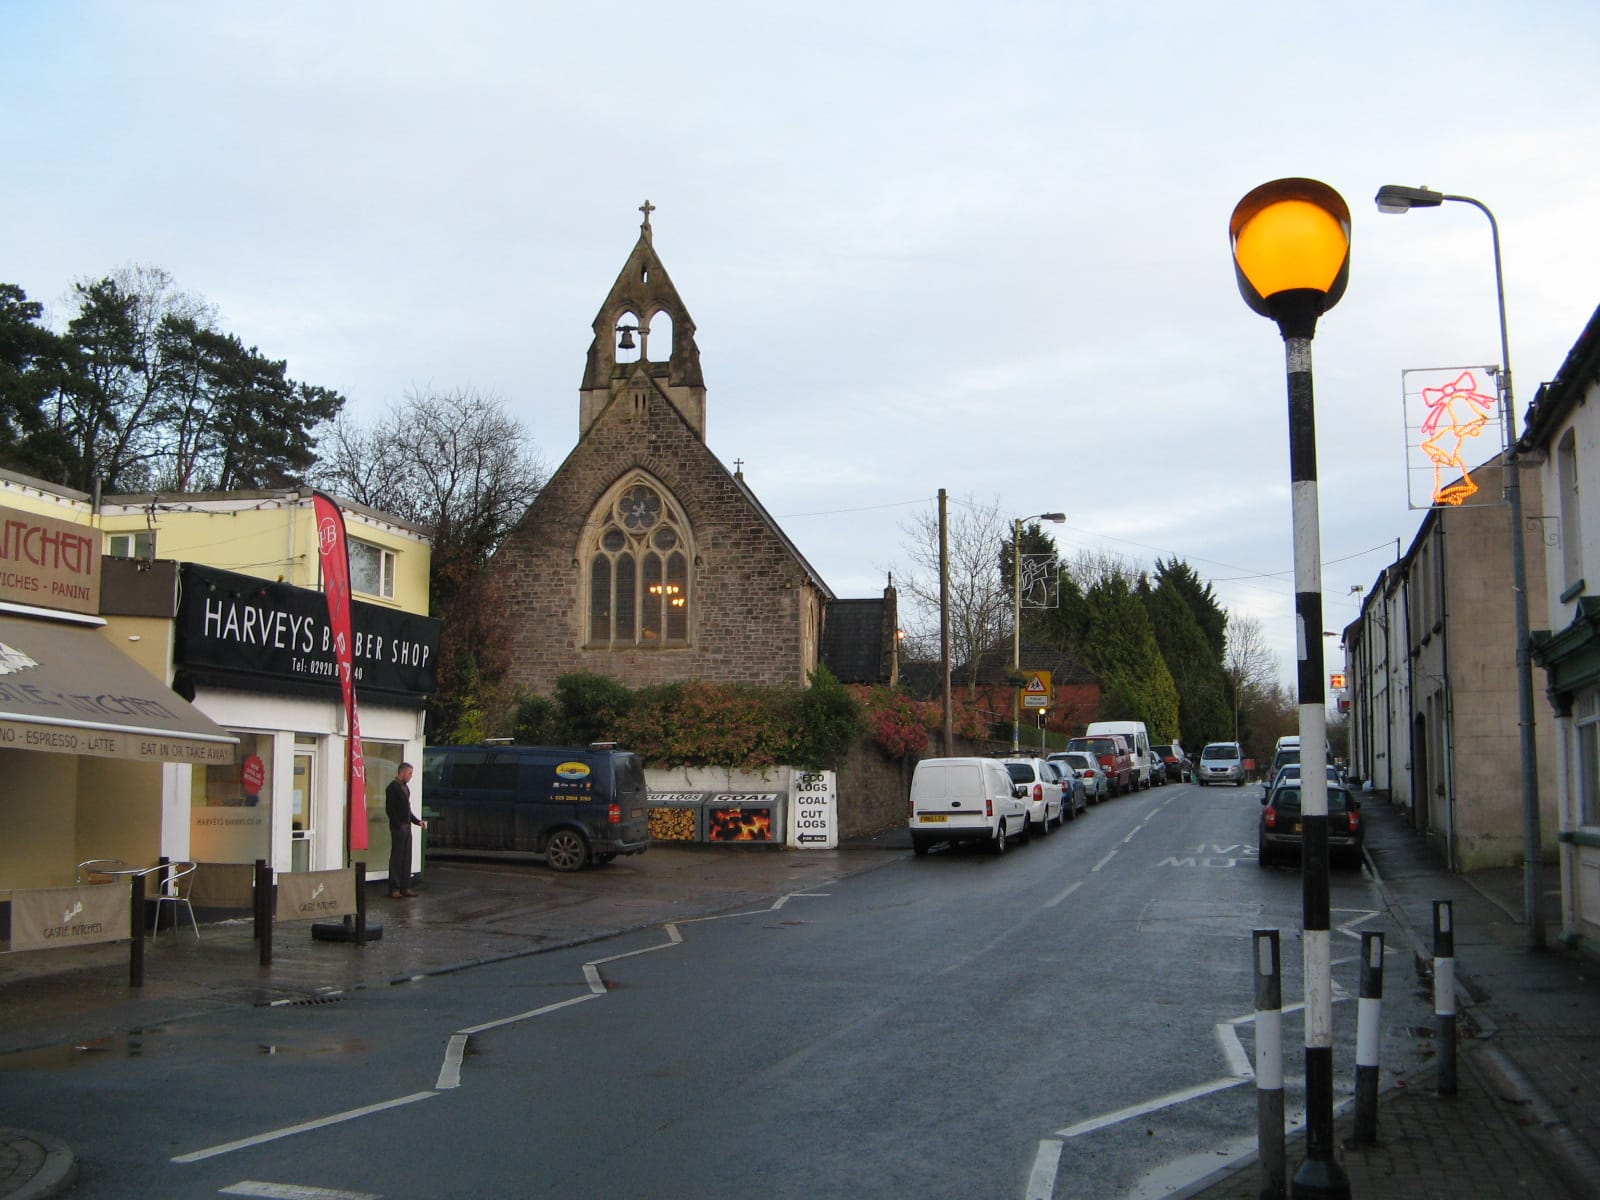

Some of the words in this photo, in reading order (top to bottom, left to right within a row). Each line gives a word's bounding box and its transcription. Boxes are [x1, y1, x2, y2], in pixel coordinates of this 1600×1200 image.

[0, 572, 39, 592] ICHES
[52, 581, 90, 601] PANINI
[204, 598, 314, 653] HARVEYS
[322, 626, 383, 661] BBER
[391, 639, 430, 668] SHOP
[292, 657, 308, 673] Tel:
[310, 660, 332, 676] 02920
[26, 731, 78, 748] ESPRESSO
[88, 737, 115, 752] LATTE
[141, 742, 157, 756] EAT
[160, 743, 169, 756] IN
[172, 745, 183, 757] OR
[185, 746, 206, 759] TAKE
[207, 748, 229, 760] AWAY
[803, 774, 825, 782] ECO
[798, 784, 828, 792] LOGS
[798, 796, 828, 805] COAL
[801, 810, 824, 819] CUT
[797, 820, 826, 829] LOGS
